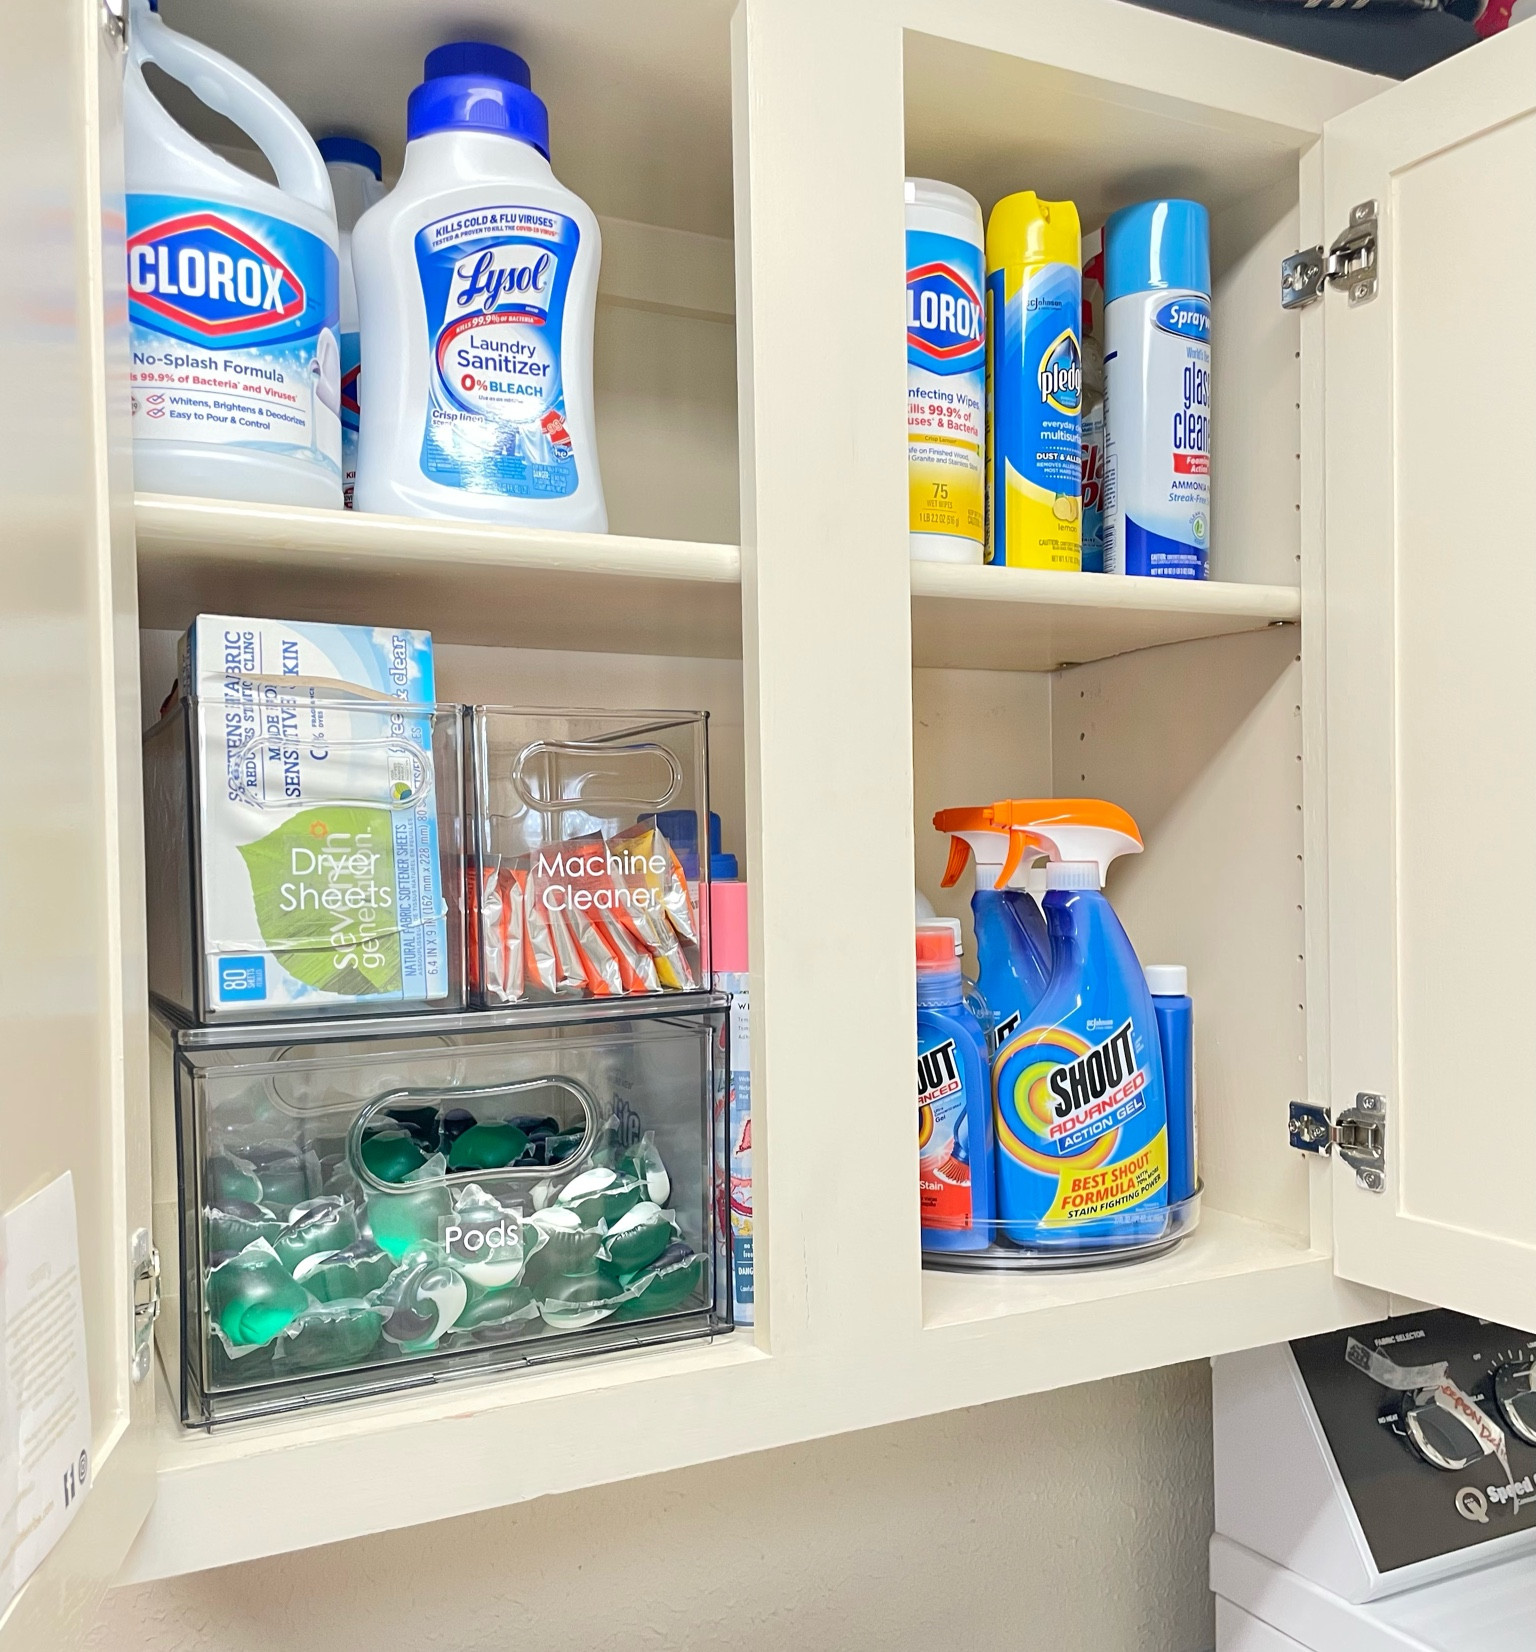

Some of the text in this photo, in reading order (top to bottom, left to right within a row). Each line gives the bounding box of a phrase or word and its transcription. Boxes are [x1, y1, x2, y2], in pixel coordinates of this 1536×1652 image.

[432, 235, 454, 248] TESTED
[460, 227, 483, 238] PROVEN
[435, 213, 554, 238] KILLS COLD & FLU VIRUSES
[130, 245, 285, 314] CLOROX
[457, 251, 550, 311] Lysol
[455, 321, 472, 333] KILLS
[472, 314, 500, 326] 99.9%
[907, 289, 980, 342] LOROX
[1169, 305, 1210, 331] Sprayw
[470, 335, 536, 358] Laundry
[133, 352, 284, 383] No-Splash Formula
[457, 349, 551, 377] Sanitizer
[140, 372, 175, 383] 99.9%
[177, 374, 189, 383] of
[242, 379, 262, 394] and
[489, 381, 543, 397] BLEACH
[1041, 361, 1082, 403] pledg
[1184, 361, 1210, 409] glas
[908, 387, 980, 410] nfecting Wipes
[169, 396, 306, 427] Whitens, Brightens & Deodorizes
[169, 410, 271, 430] Easy to Pour & Control
[432, 409, 484, 423] Crisp linen
[928, 404, 961, 419] 99.9%
[964, 412, 971, 422] of
[908, 417, 979, 437] uses & Bacteria
[1042, 421, 1075, 431] everyday
[1173, 409, 1210, 452] clean
[912, 454, 935, 463] Granite
[929, 448, 953, 458] Finished
[1036, 452, 1065, 461] DUST &
[932, 482, 948, 499] 75
[1058, 523, 1077, 532] lemon
[242, 631, 254, 671] CLING
[389, 635, 408, 685] clear
[309, 687, 317, 728] FRAGNCE
[267, 715, 281, 761] MDE
[282, 697, 301, 798] SENSTIVE
[244, 728, 257, 787] REDUES
[416, 810, 427, 822] 80
[418, 825, 430, 844] mm)
[292, 847, 380, 881] Dryer
[419, 848, 430, 864] 228
[537, 850, 666, 878] Machine
[421, 875, 432, 892] mm
[280, 881, 391, 912] Sheets
[395, 824, 417, 976] NATURAL FABRIC SOFTENER SHEETS
[422, 895, 434, 914] (162
[543, 884, 660, 911] Cleaner
[415, 927, 423, 976] ASSOUPLISSEU
[426, 947, 437, 957] IN
[223, 969, 247, 990] 80
[427, 961, 438, 975] 6.4
[918, 1041, 955, 1095] OUT
[1050, 1021, 1135, 1118] SHOUT
[918, 1081, 959, 1104] ANCED
[1050, 1072, 1145, 1138] ADVANCED
[935, 1115, 946, 1123] Gel
[1064, 1098, 1144, 1148] ACTION GEL
[1071, 1153, 1149, 1193] BEST SHOUT
[1136, 1170, 1148, 1181] WITH
[1147, 1165, 1159, 1178] MORE
[920, 1180, 944, 1191] Stain
[1061, 1178, 1135, 1210] FORMULA
[1068, 1205, 1098, 1218] STAIN
[1100, 1190, 1140, 1211] FIGHTING
[1141, 1173, 1161, 1194] POWER
[445, 1220, 519, 1253] Pods
[738, 1267, 753, 1275] DANG
[1395, 1330, 1425, 1342] SELECTOR
